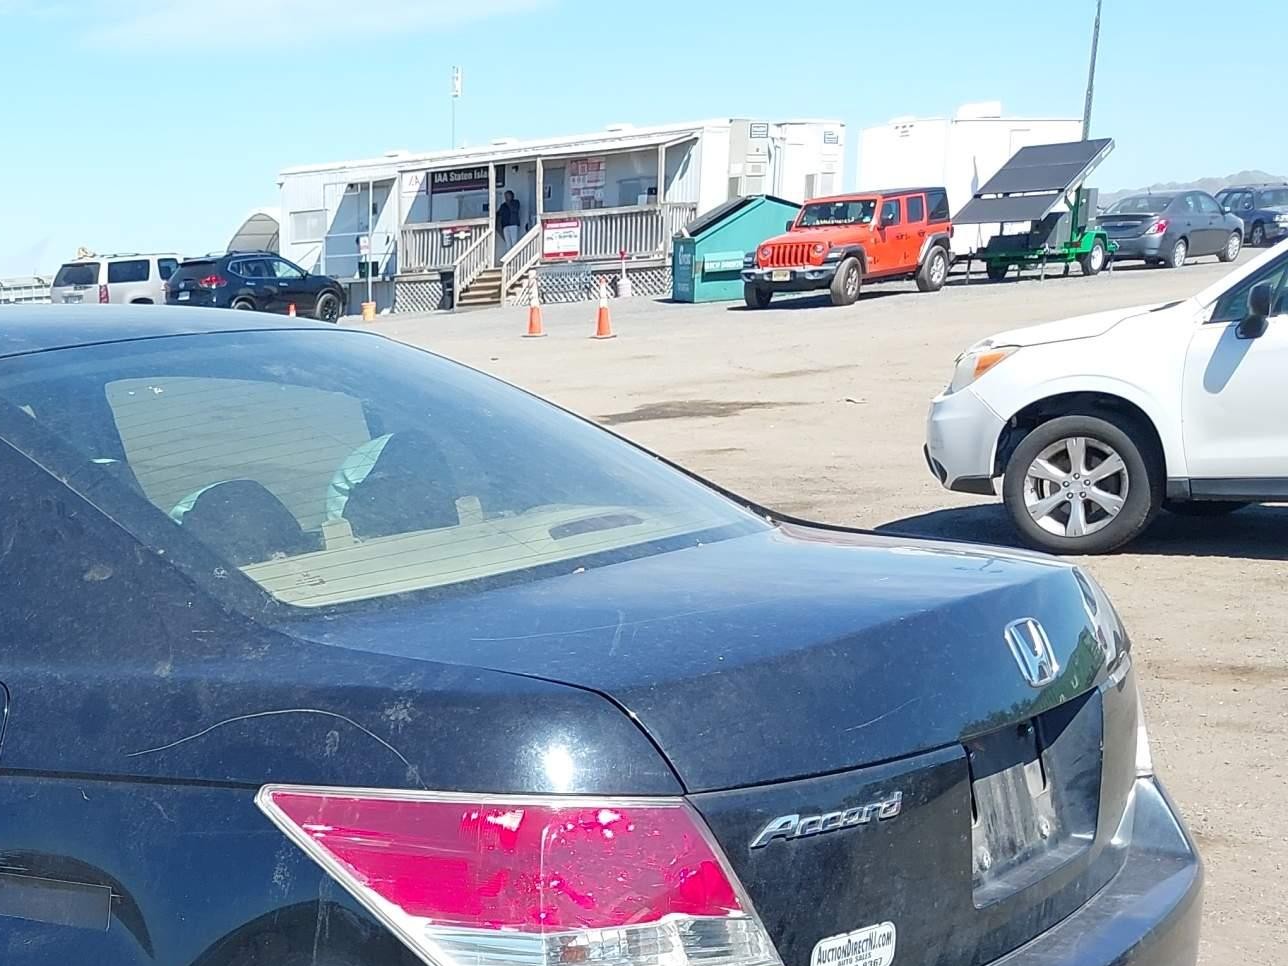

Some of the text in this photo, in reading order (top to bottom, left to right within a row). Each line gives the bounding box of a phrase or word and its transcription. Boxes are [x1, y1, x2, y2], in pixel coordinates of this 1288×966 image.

[434, 173, 448, 184] IAA
[449, 171, 472, 182] Staten
[474, 169, 488, 179] Isla
[750, 791, 902, 849] Accord
